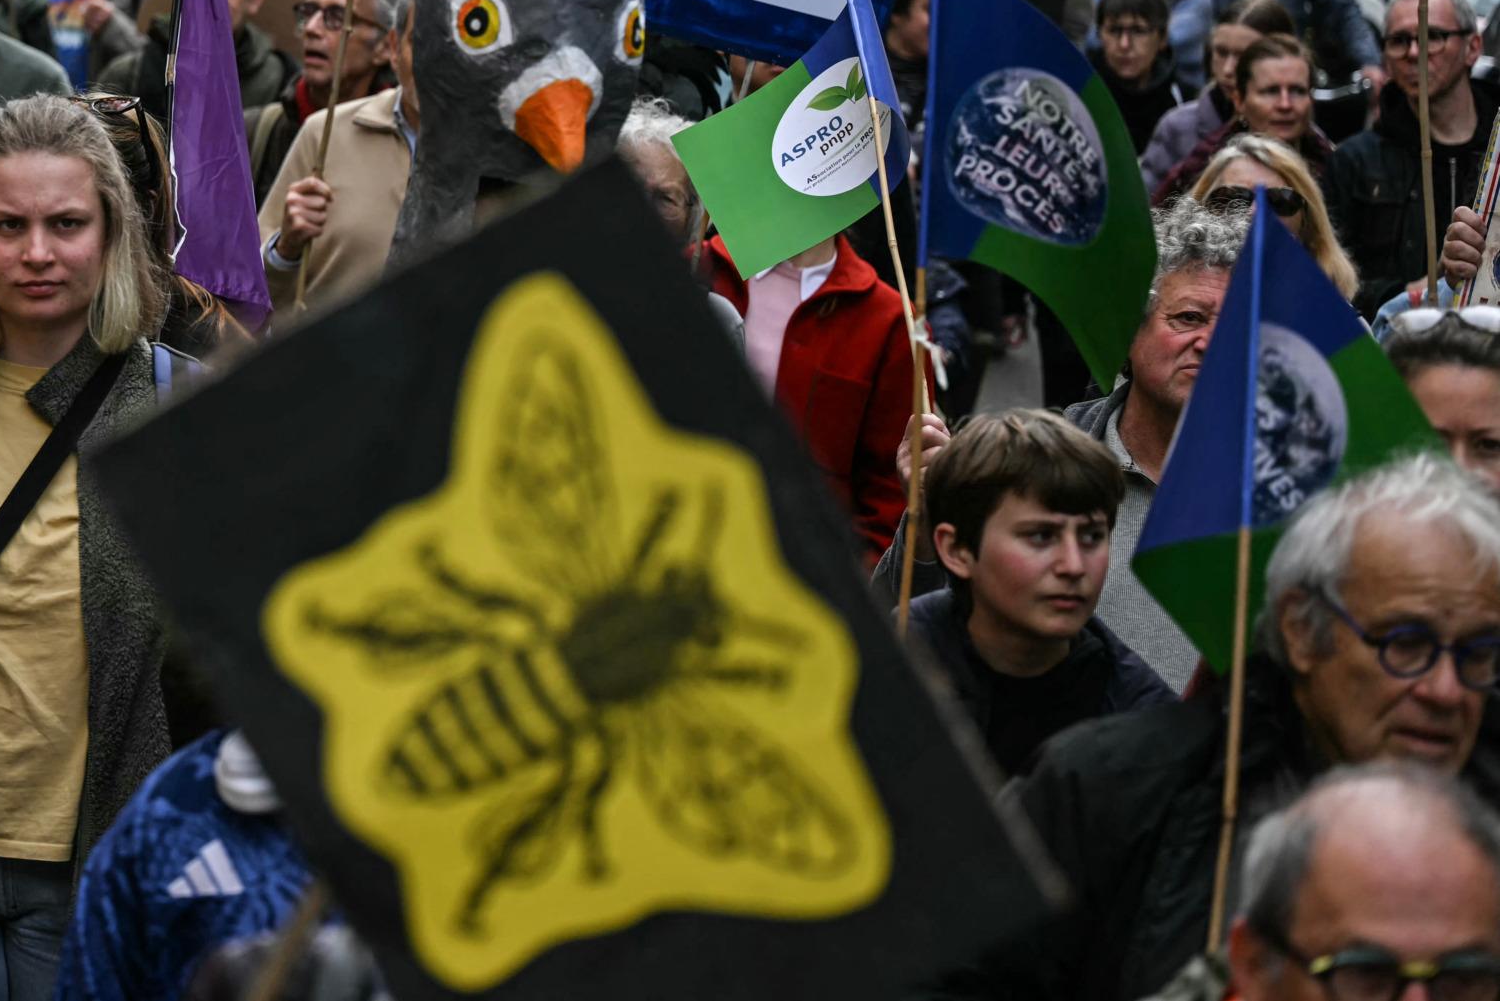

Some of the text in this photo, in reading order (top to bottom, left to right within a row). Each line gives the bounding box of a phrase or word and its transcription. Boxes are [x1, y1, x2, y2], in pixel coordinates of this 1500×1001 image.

[781, 116, 843, 167] ASPRO
[820, 122, 854, 156] pnpp
[1014, 79, 1098, 169] NOTRE
[806, 158, 842, 184] ASsociation
[843, 148, 854, 160] pour
